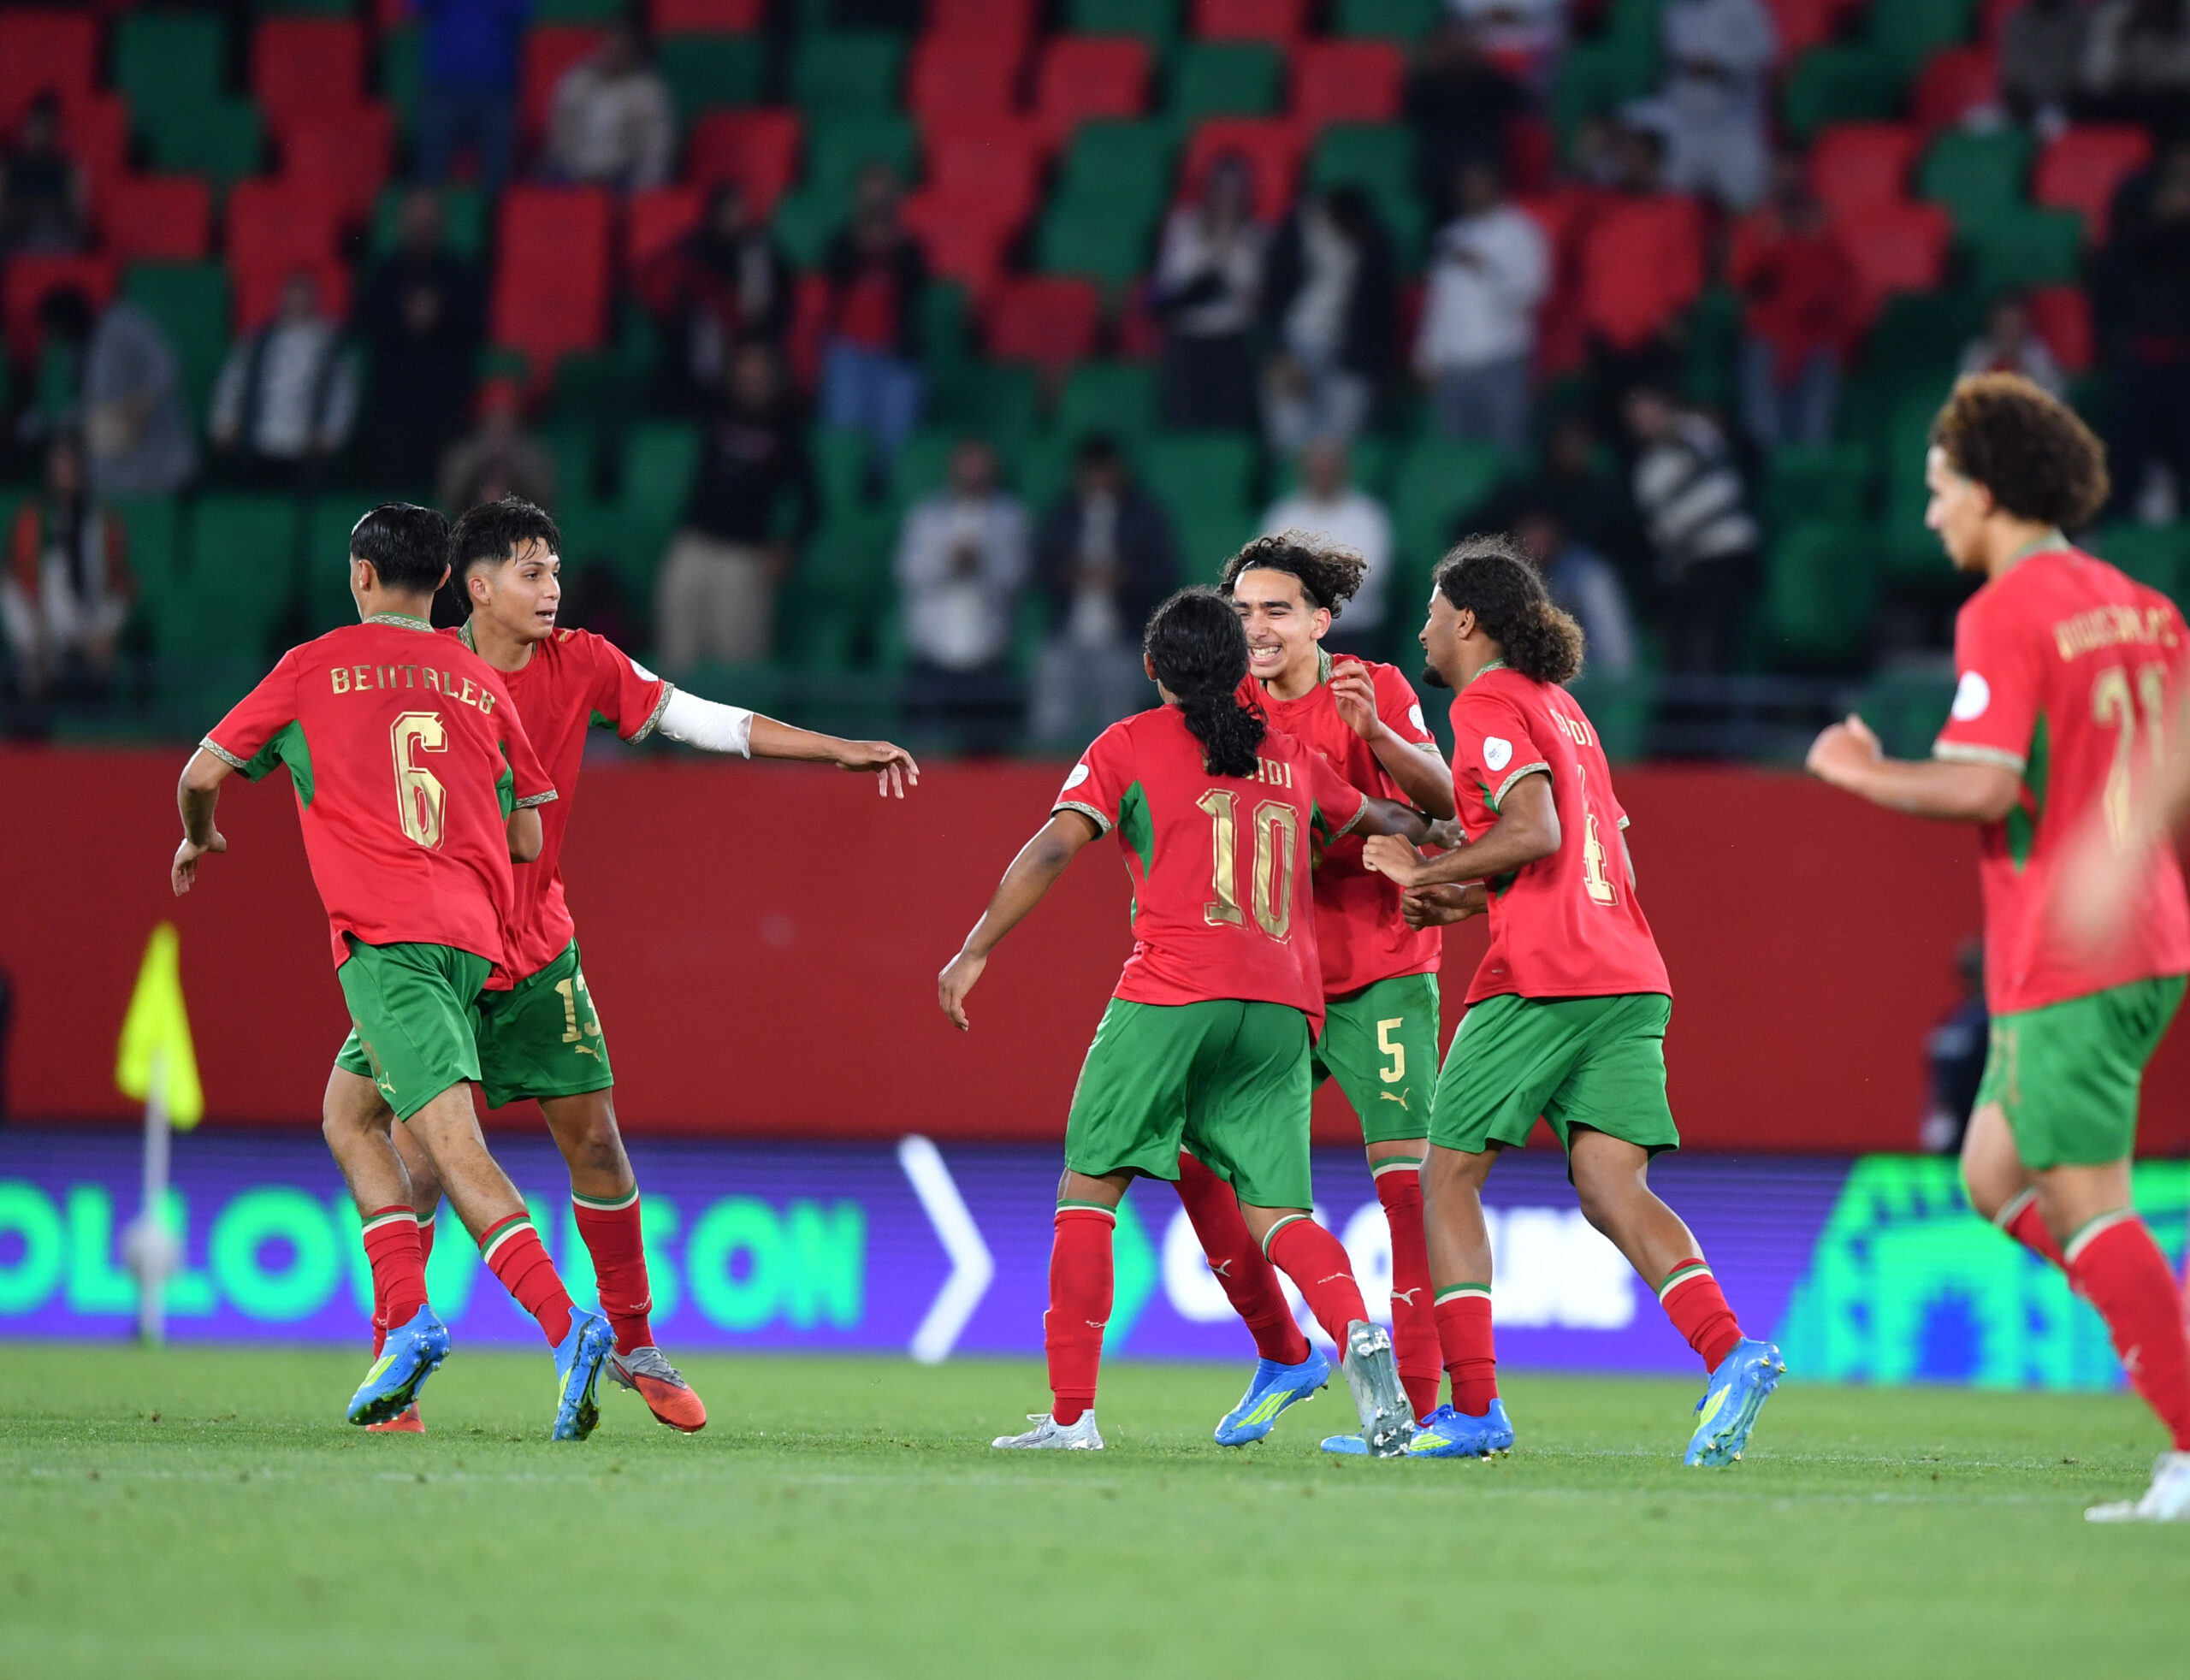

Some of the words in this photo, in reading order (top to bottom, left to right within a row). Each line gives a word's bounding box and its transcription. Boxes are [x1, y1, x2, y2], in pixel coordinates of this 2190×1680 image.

[329, 664, 496, 715] BENTALEB
[390, 711, 448, 852] 6
[1195, 787, 1300, 945] 10
[1376, 1016, 1406, 1084] 5
[690, 1195, 867, 1331] ON
